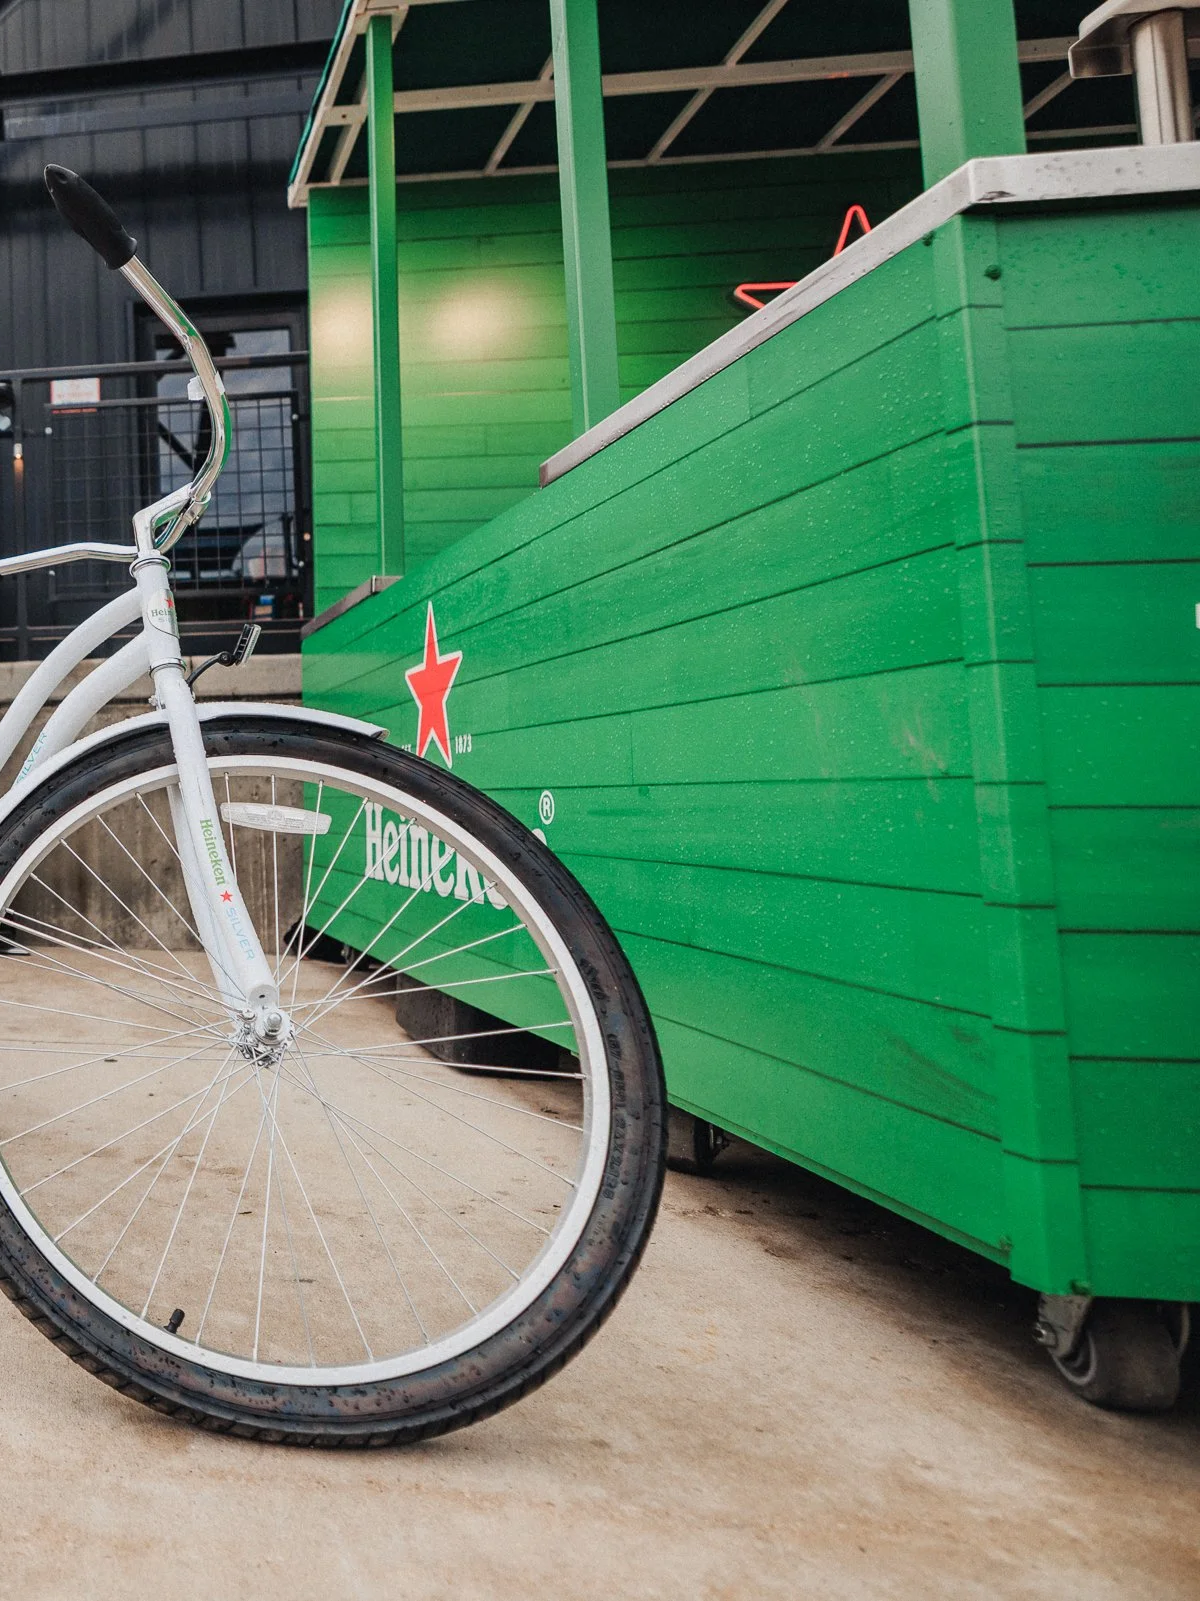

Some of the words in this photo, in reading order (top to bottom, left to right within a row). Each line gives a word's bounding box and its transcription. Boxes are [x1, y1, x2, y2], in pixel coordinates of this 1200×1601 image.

[16, 732, 47, 784] SILVER
[454, 734, 473, 754] 1873
[200, 819, 227, 886] Heineken
[226, 906, 255, 961] SILVER
